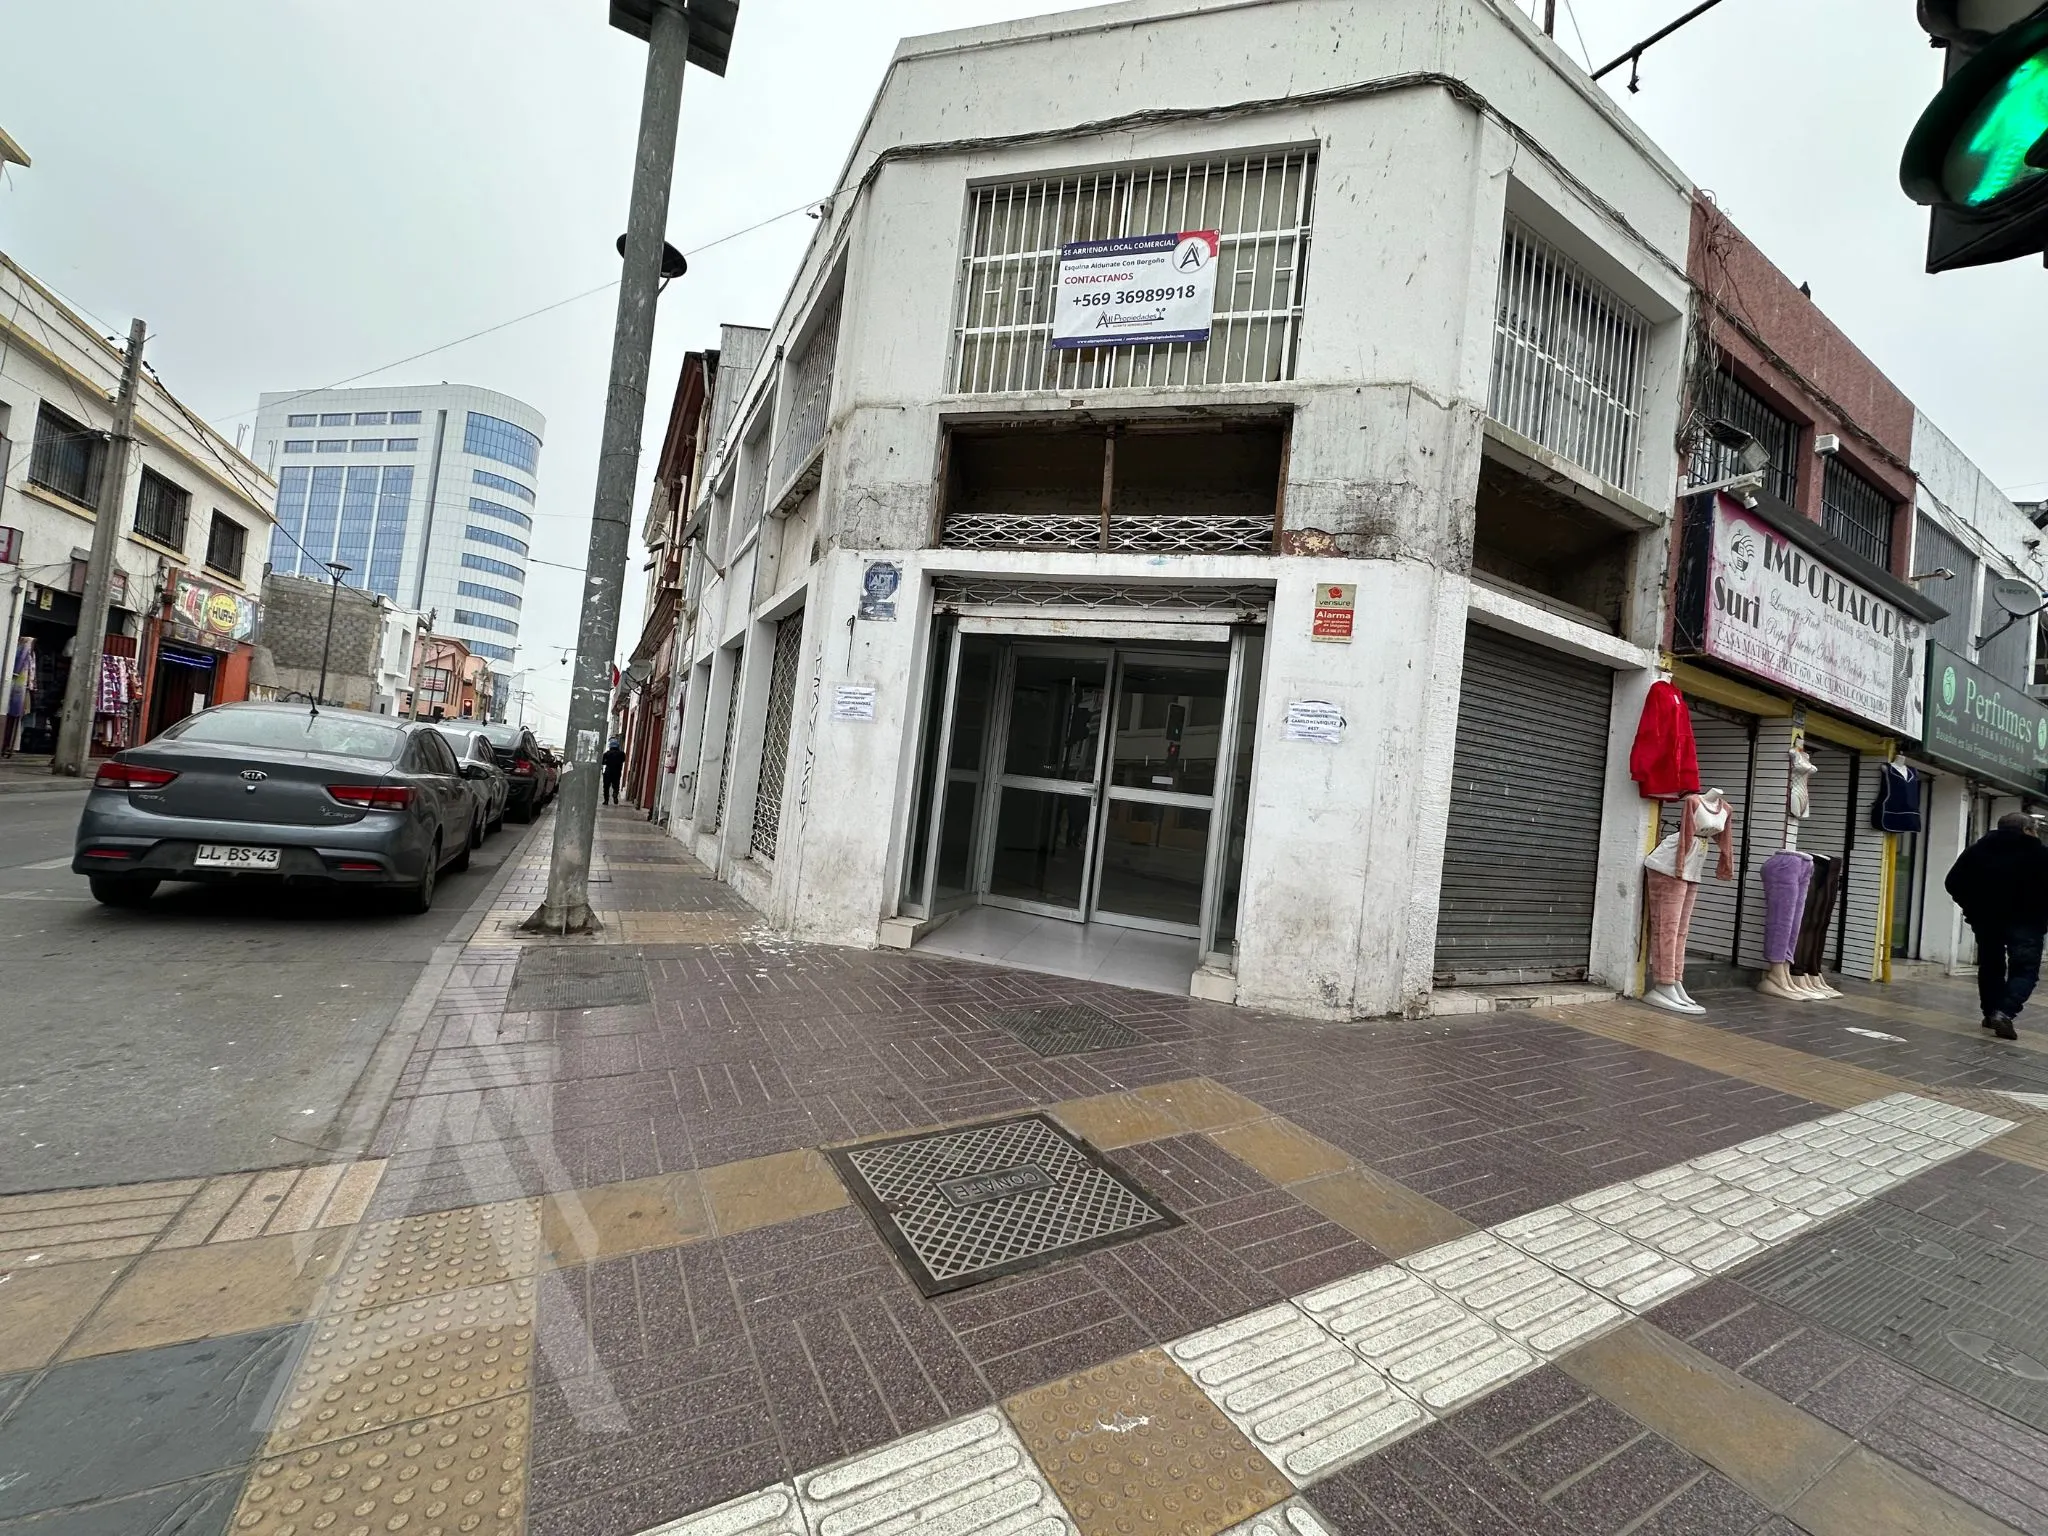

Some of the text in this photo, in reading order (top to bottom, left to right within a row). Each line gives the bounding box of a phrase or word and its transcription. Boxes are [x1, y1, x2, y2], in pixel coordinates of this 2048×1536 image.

[1072, 246, 1108, 255] ARRIENDA
[1109, 243, 1132, 252] LOCAL
[1133, 239, 1175, 249] COMERCIAL
[1091, 261, 1120, 269] Aldunate
[1064, 272, 1134, 285] CONTACTANOS
[1072, 284, 1195, 307] +569 36989918
[1113, 313, 1157, 322] Propiedades
[1714, 576, 1760, 629] Suri
[1316, 610, 1351, 619] Alarma
[1718, 626, 1740, 649] CASA
[1743, 638, 1775, 663] MATRIZ
[1815, 673, 1850, 700] SUCURSAL
[1851, 689, 1888, 714] COQUIMBO
[1964, 677, 2032, 743] Perfumes
[244, 772, 263, 780] KIA
[952, 1171, 1038, 1198] CONAFE
